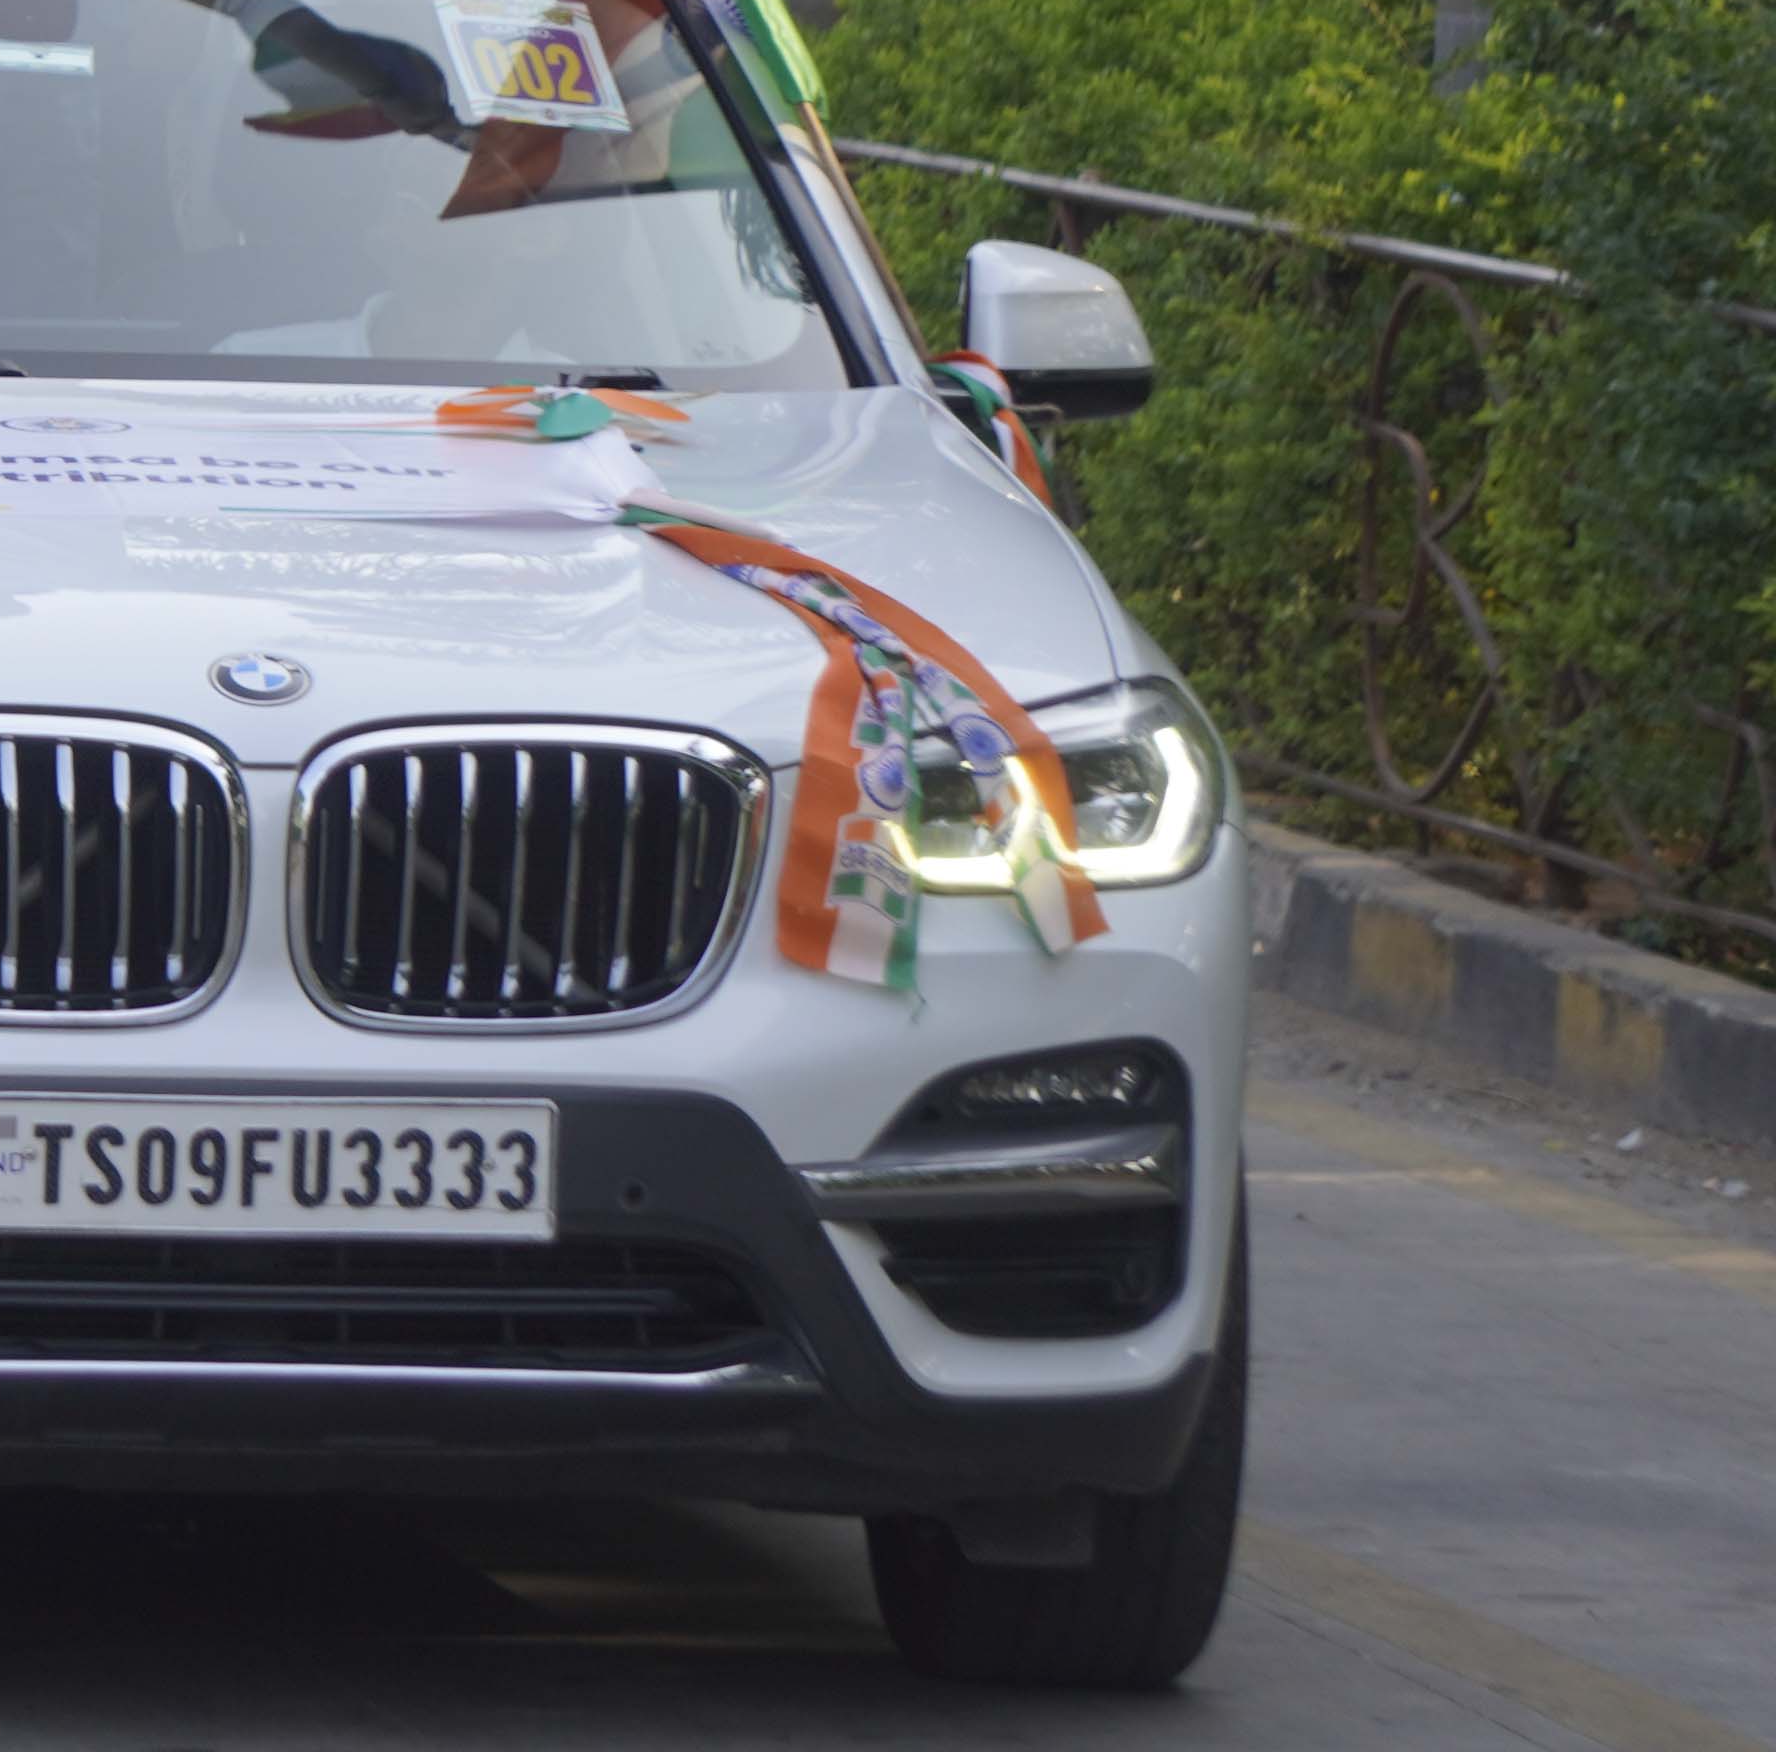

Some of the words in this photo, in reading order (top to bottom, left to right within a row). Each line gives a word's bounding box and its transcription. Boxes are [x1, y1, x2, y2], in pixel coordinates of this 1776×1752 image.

[473, 39, 595, 104] 002
[199, 455, 301, 470] be
[320, 462, 456, 478] our
[33, 1122, 538, 1211] TS09FU3333
